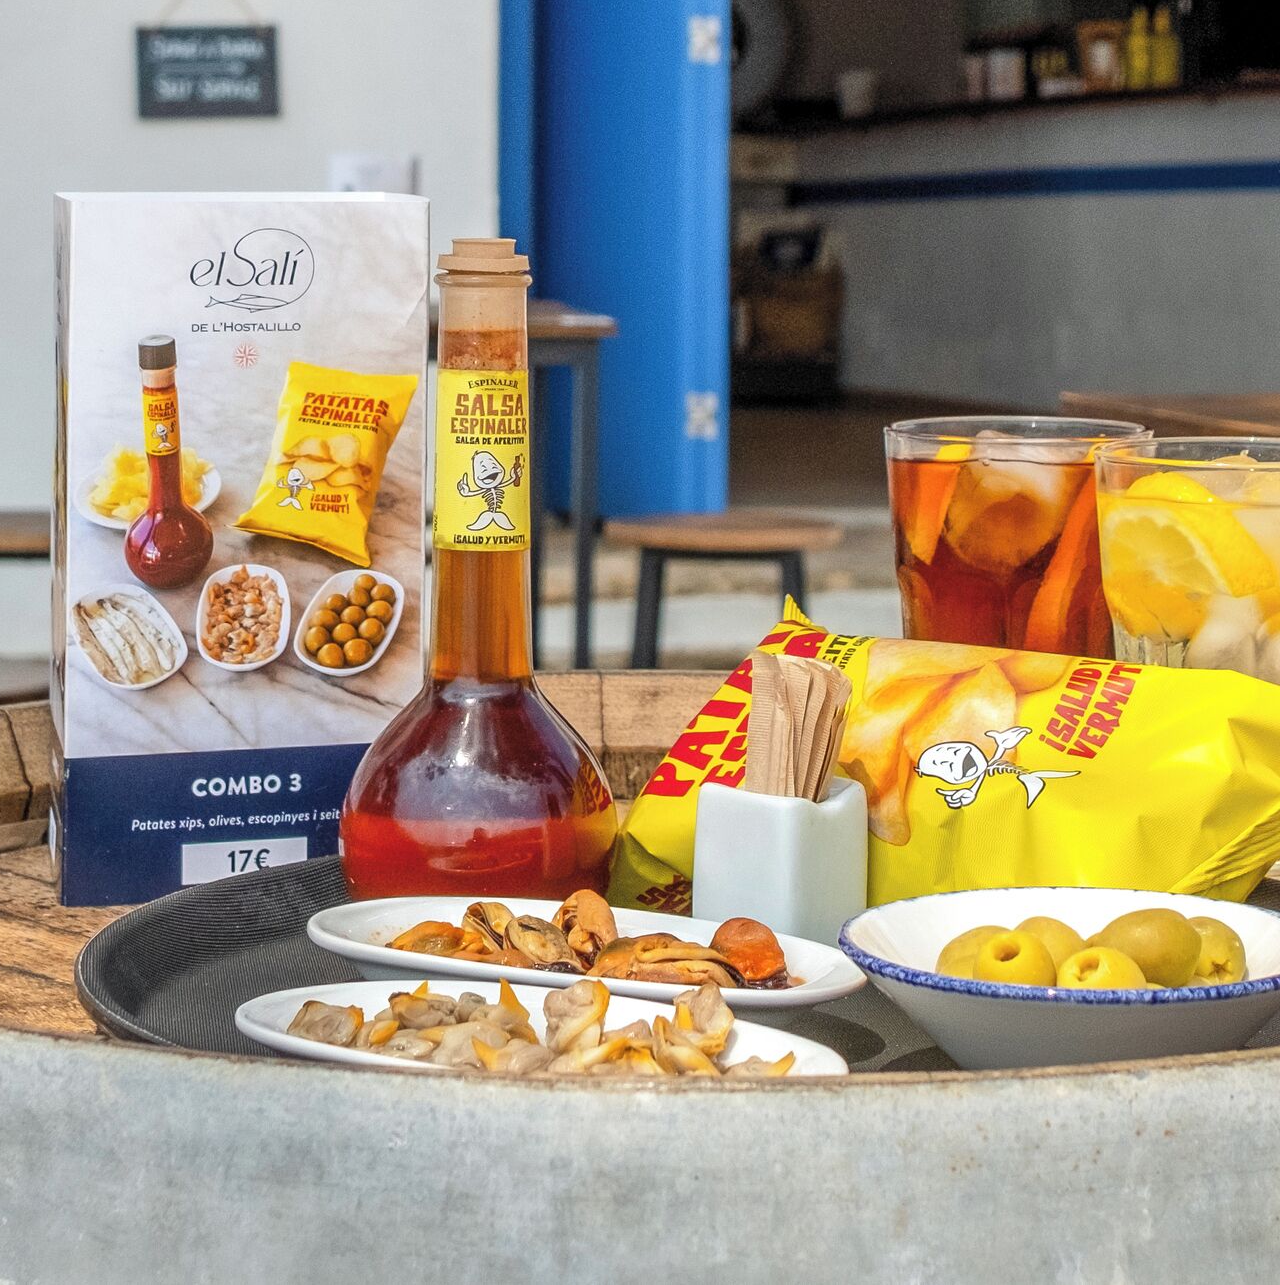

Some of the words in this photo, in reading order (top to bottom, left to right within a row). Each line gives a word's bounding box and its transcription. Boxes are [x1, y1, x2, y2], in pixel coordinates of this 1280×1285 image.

[191, 323, 209, 333] DE
[468, 378, 519, 390] ESPINALER
[301, 404, 382, 427] ESPINALER
[304, 392, 390, 417] PATATAS
[455, 393, 524, 416] SALSA
[450, 416, 527, 435] ESPINALER
[455, 436, 480, 445] SALSA
[482, 437, 491, 445] DE
[485, 535, 492, 545] Y
[191, 774, 282, 798] COMBO
[289, 773, 303, 793] 3
[131, 818, 177, 832] Patates
[179, 815, 206, 831] xips,
[208, 814, 245, 827] olives,
[248, 809, 310, 825] escopinyes
[321, 808, 341, 821] seit
[228, 848, 271, 873] 17€
